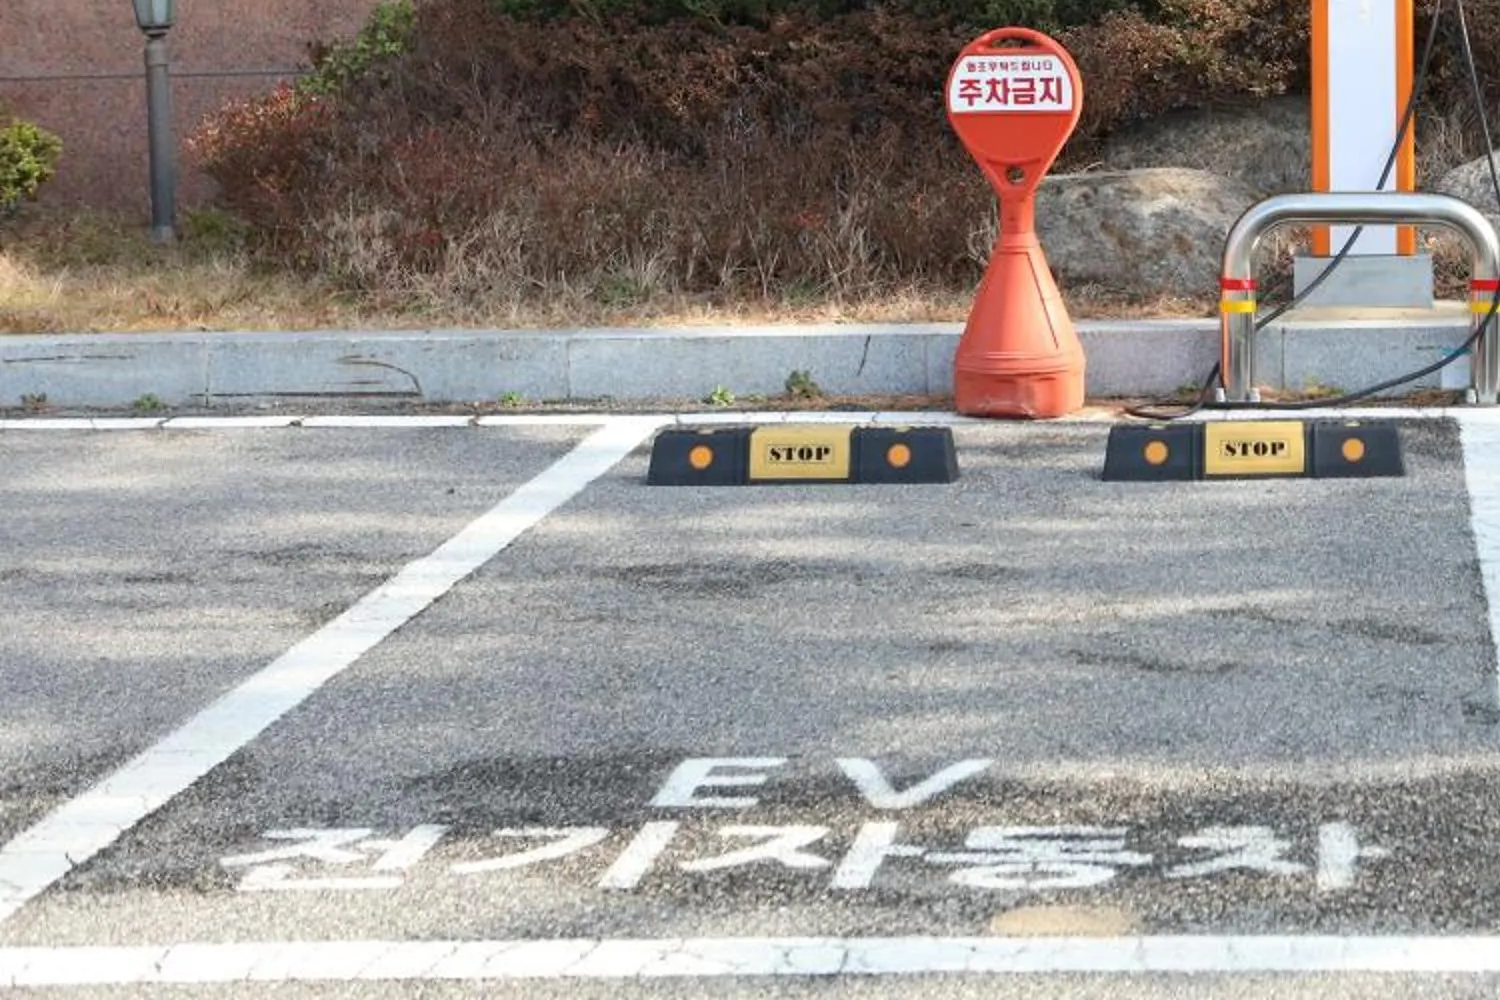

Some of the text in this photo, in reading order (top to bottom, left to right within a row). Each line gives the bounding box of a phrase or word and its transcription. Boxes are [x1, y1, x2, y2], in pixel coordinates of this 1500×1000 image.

[959, 77, 1062, 106] 주차금지
[770, 447, 830, 461] STOP
[1224, 441, 1285, 457] STOP
[649, 757, 995, 807] EV
[219, 821, 1391, 891] 전기자동차
